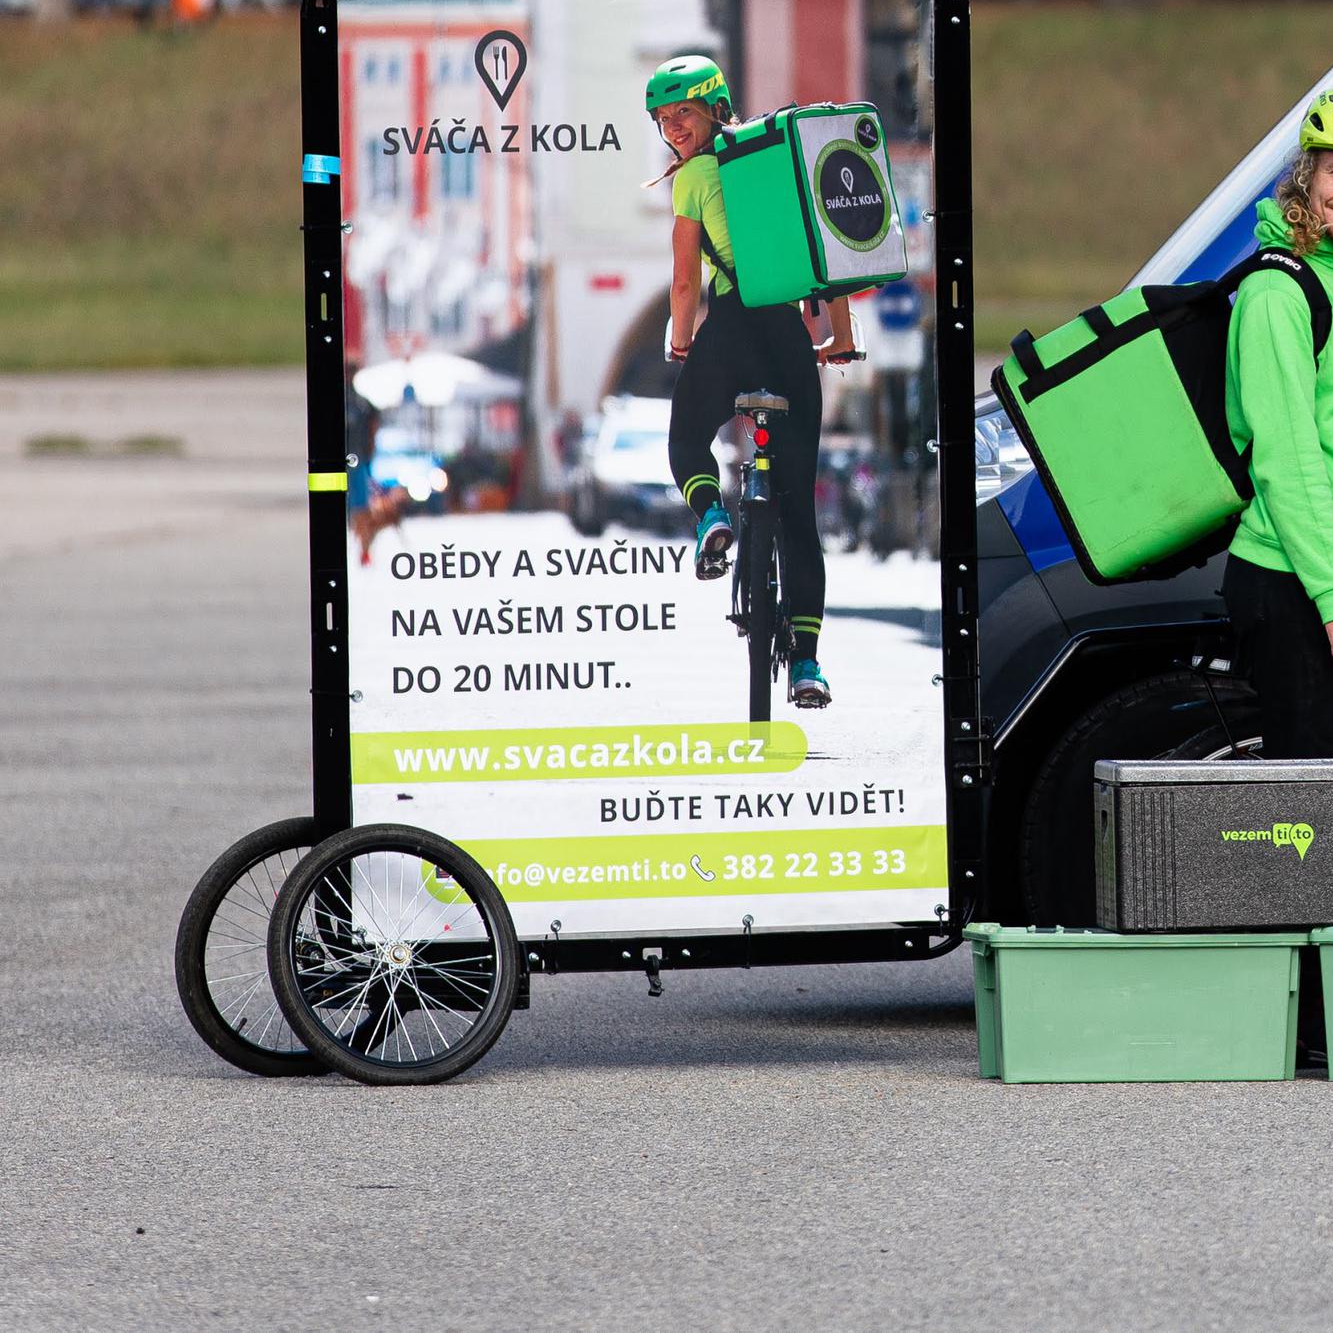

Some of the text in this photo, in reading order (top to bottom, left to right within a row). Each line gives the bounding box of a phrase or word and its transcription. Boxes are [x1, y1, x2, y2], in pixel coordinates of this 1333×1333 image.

[686, 72, 725, 100] FOX
[383, 118, 622, 156] SVÁČA Z KOLA
[826, 193, 882, 210] SVÁČA Z KOLA
[390, 539, 688, 580] OBĚDY A SVAČINY
[391, 599, 677, 637] NA VAŠEM STOLE
[392, 660, 632, 694] DO 20 MINUT..
[394, 732, 766, 773] www.svacazkola.cz
[600, 783, 906, 823] BUĎTE TAKY VIDĚT!
[1221, 827, 1272, 842] vezem
[723, 854, 774, 881] 382
[784, 852, 820, 879] 22
[828, 850, 863, 877] 33
[872, 848, 907, 876] 33
